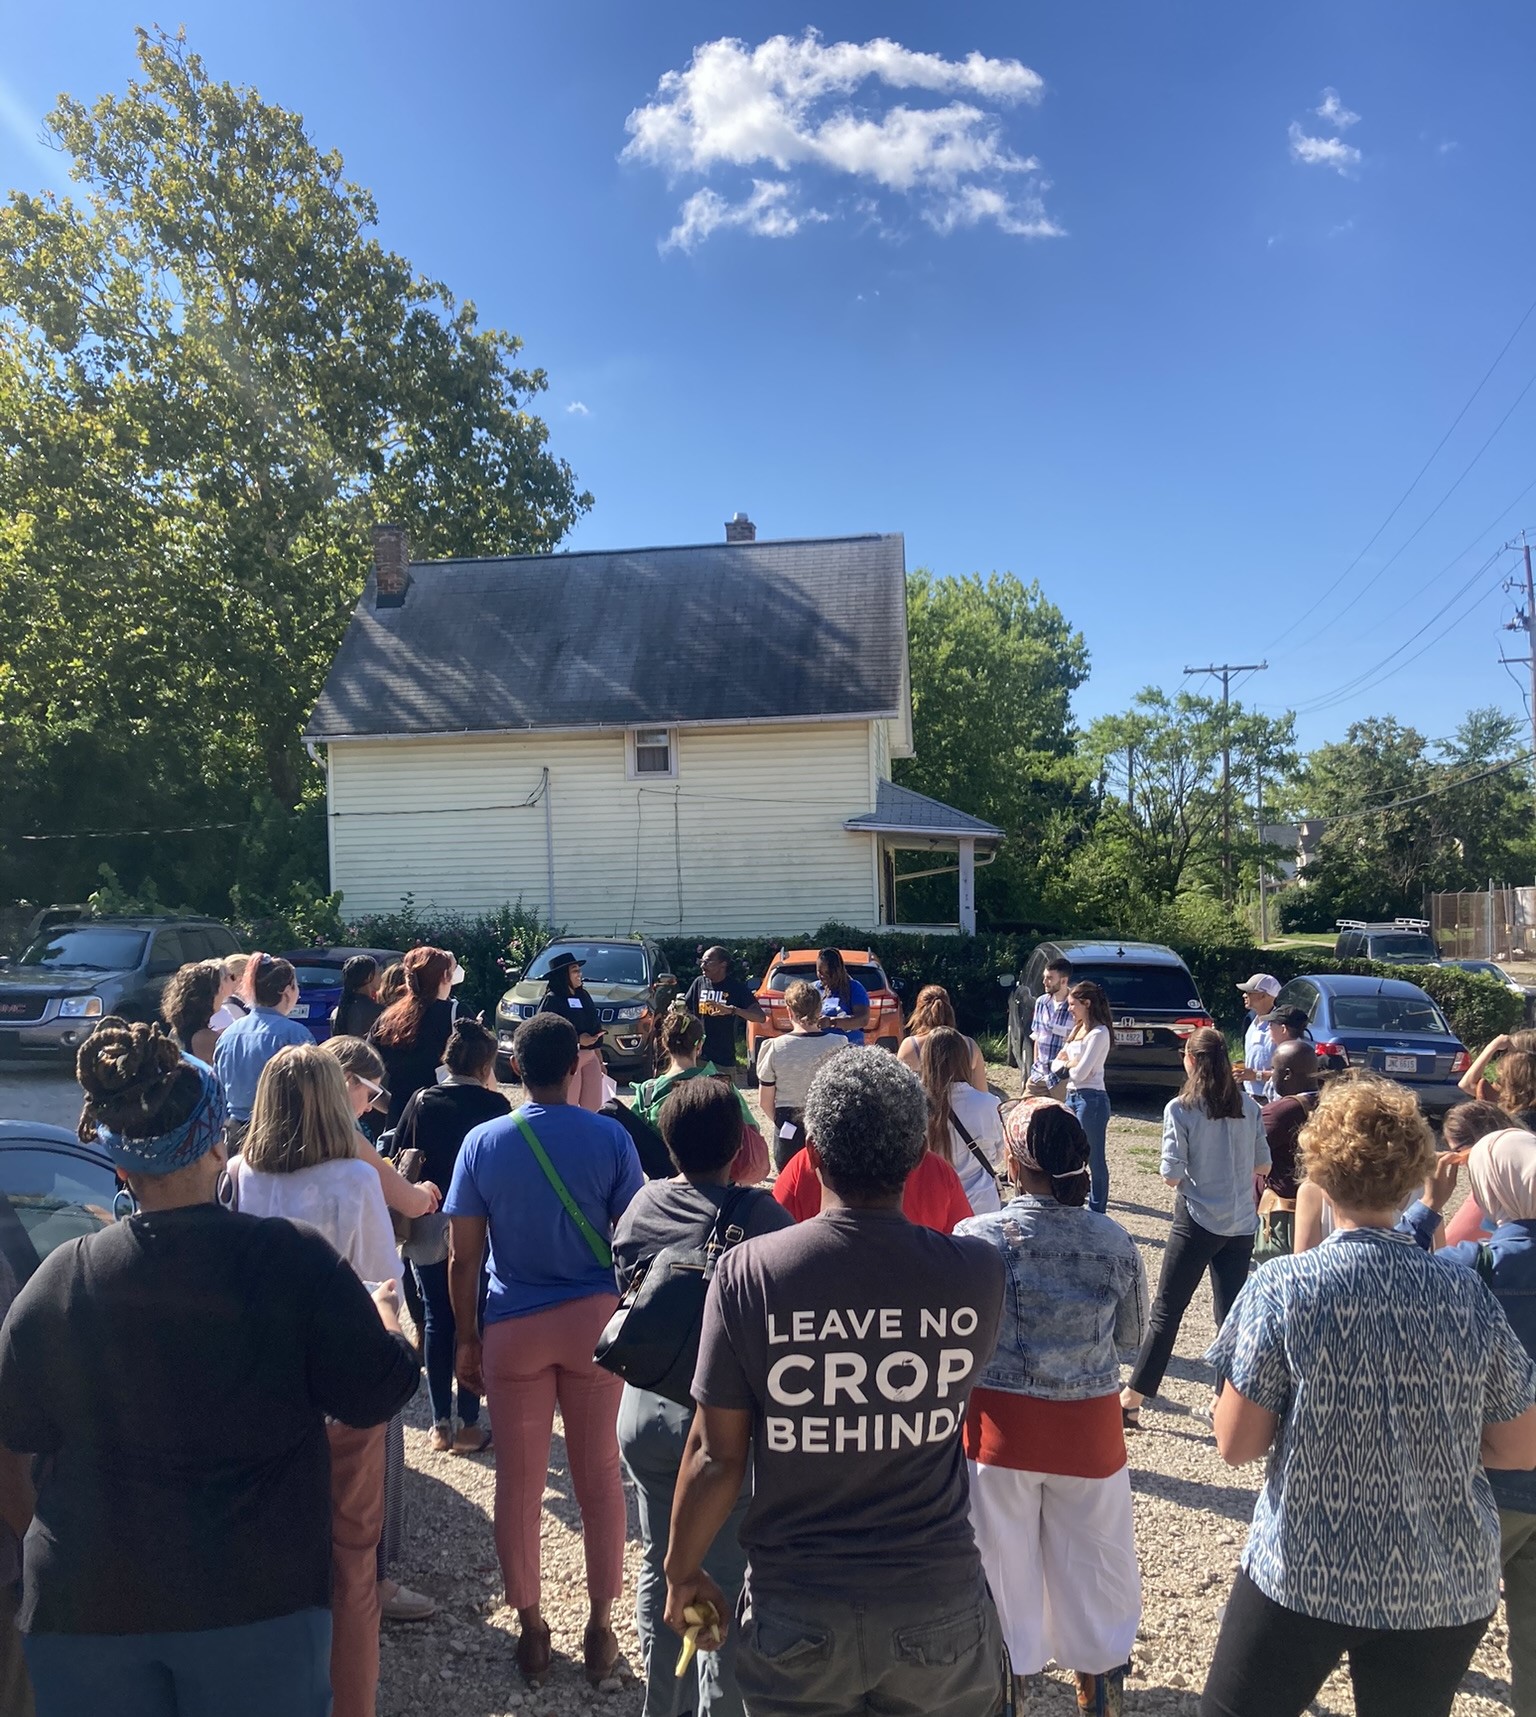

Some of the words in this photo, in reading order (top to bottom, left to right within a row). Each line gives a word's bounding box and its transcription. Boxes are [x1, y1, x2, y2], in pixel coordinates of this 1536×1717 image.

[699, 989, 727, 1004] SOIL
[767, 1308, 903, 1345] LEAVE
[920, 1306, 979, 1338] NO
[766, 1348, 974, 1407] CROP
